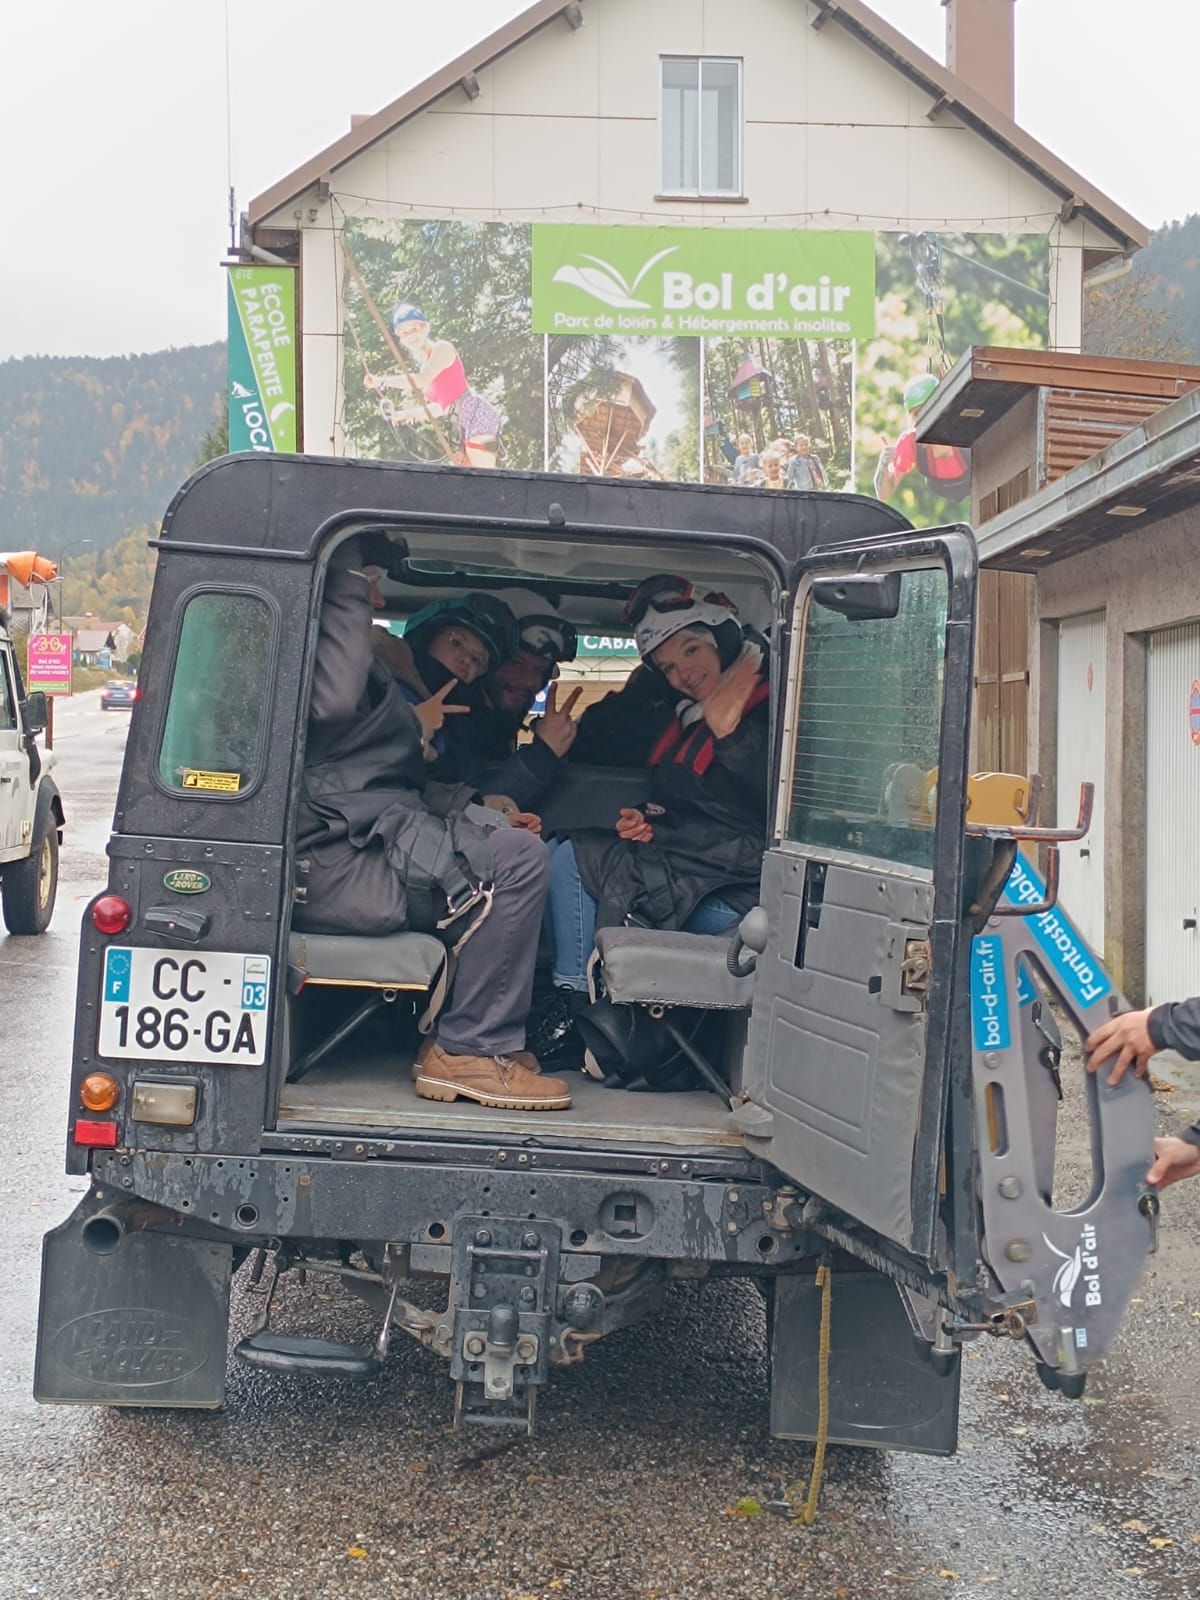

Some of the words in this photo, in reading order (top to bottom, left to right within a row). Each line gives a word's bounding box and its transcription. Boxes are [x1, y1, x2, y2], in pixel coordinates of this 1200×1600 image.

[663, 271, 733, 311] Bol
[745, 272, 852, 313] d'air
[260, 282, 291, 348] ÉCOLE
[553, 312, 591, 329] Parc
[594, 313, 614, 329] de
[618, 314, 657, 330] loisirs
[661, 315, 674, 330] &
[678, 314, 790, 333] Hébergements
[793, 316, 851, 333] insolites
[240, 287, 284, 397] PARAPENTE
[112, 981, 123, 994] F
[243, 984, 266, 1006] 03
[976, 940, 1001, 1047] bol-d-air.fr
[115, 1005, 257, 1055] 186-GA
[1080, 1223, 1099, 1270] d'air
[1084, 1275, 1102, 1307] Bol
